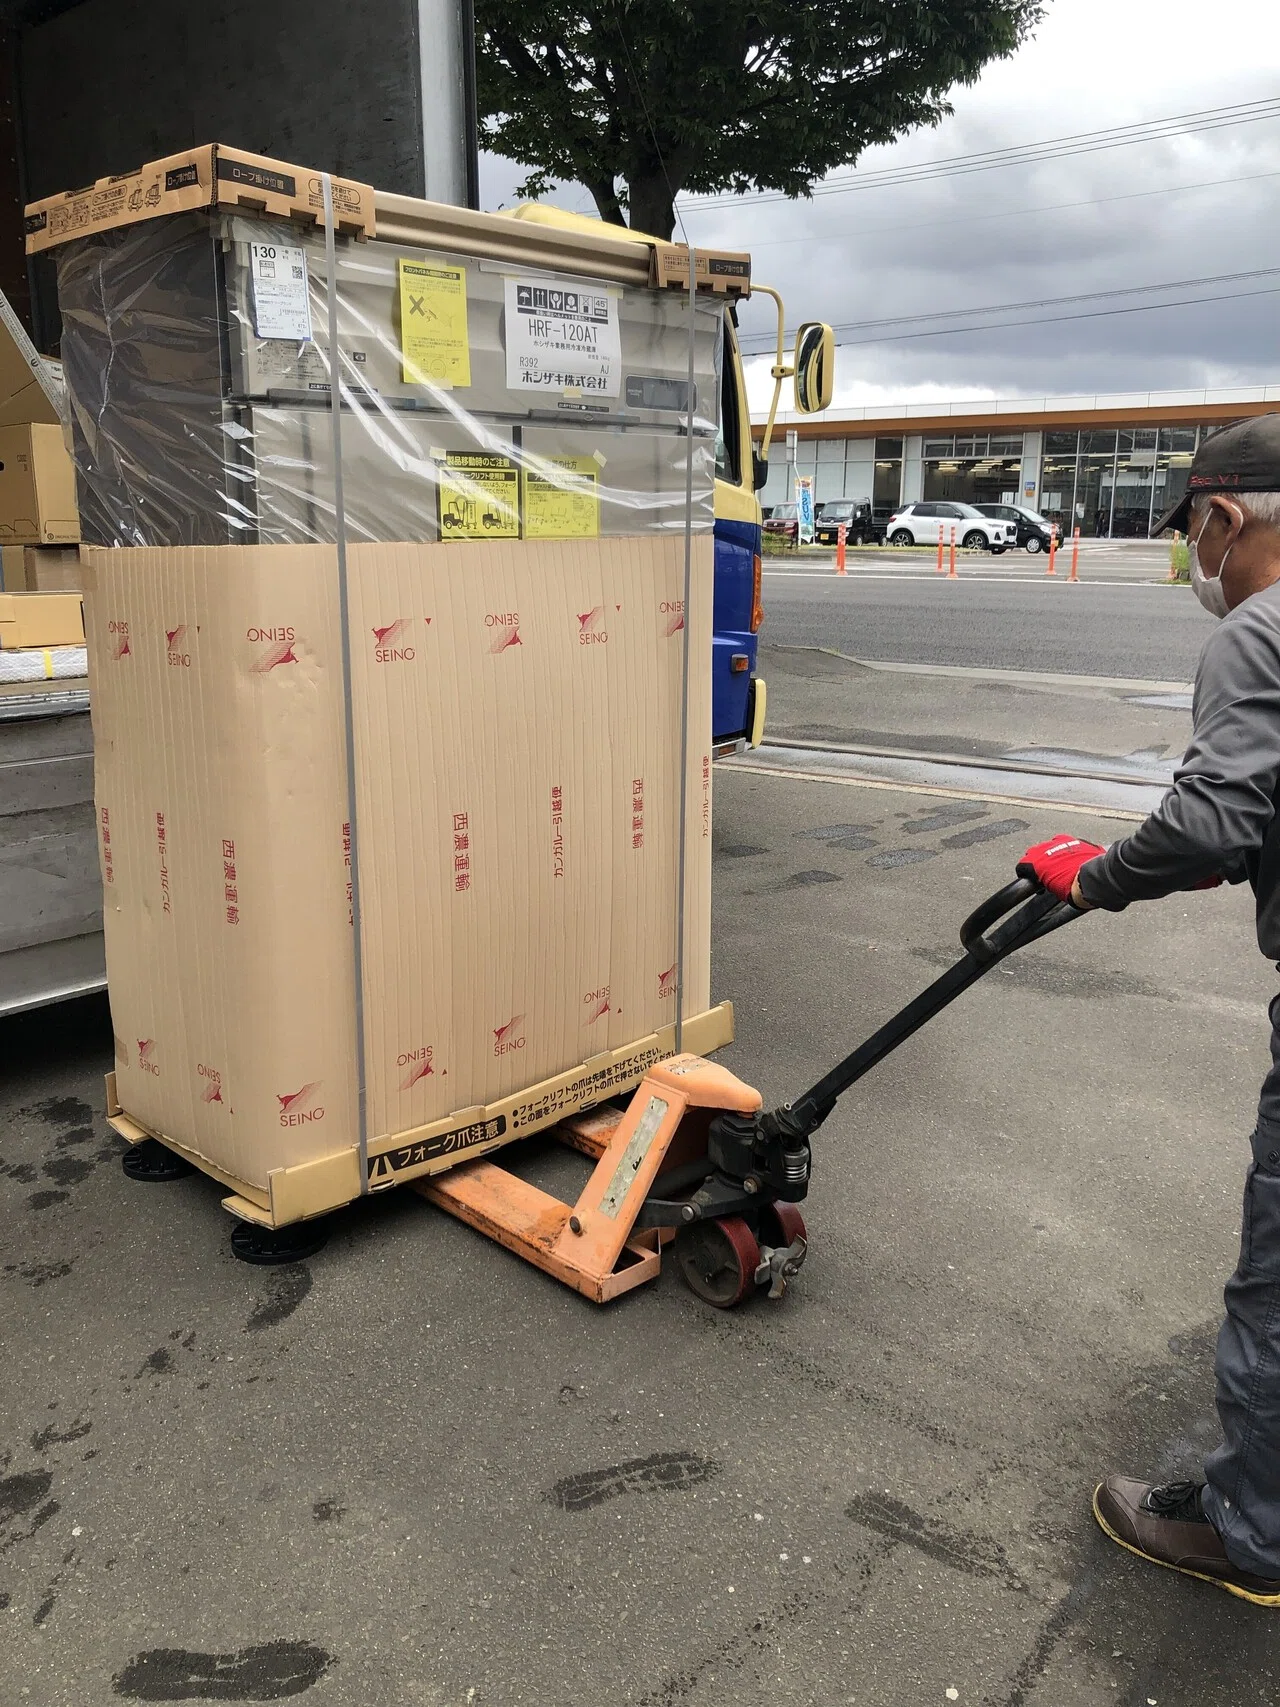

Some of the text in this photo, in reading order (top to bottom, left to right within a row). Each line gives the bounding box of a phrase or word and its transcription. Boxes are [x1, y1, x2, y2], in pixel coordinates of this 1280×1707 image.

[232, 167, 285, 190] ロープ掛け位置
[252, 245, 276, 259] 130
[528, 318, 598, 343] HRF-120AT
[533, 340, 597, 353] ホシザキ業務用冷凍冷蔵庫
[519, 356, 539, 369] R392
[600, 364, 610, 375] AJ
[522, 370, 608, 390] ホシザキ株式会社
[446, 455, 511, 468] 製品移動時のご注意
[108, 620, 129, 634] SEINO
[484, 613, 519, 627] SEINO
[246, 627, 295, 642] SEINO
[579, 631, 609, 646] SEINO
[168, 652, 191, 667] SEINO
[375, 647, 416, 663] SEINO
[632, 778, 644, 849] 西濃運輸
[551, 785, 564, 879] カンガルー引越便
[101, 807, 114, 883] 西濃運輸
[452, 812, 470, 892] 西濃運輸
[156, 812, 171, 914] カンガルー引越便
[221, 839, 240, 926] 西濃運輸
[583, 985, 611, 1004] SEINO
[658, 984, 678, 1000] SEIN
[396, 1045, 434, 1066] SEINO
[493, 1036, 526, 1057] SEINO
[138, 1057, 160, 1077] SEINO
[197, 1063, 221, 1084] SEINO
[279, 1106, 325, 1127] SEINO
[397, 1119, 500, 1167] フォーク爪注意
